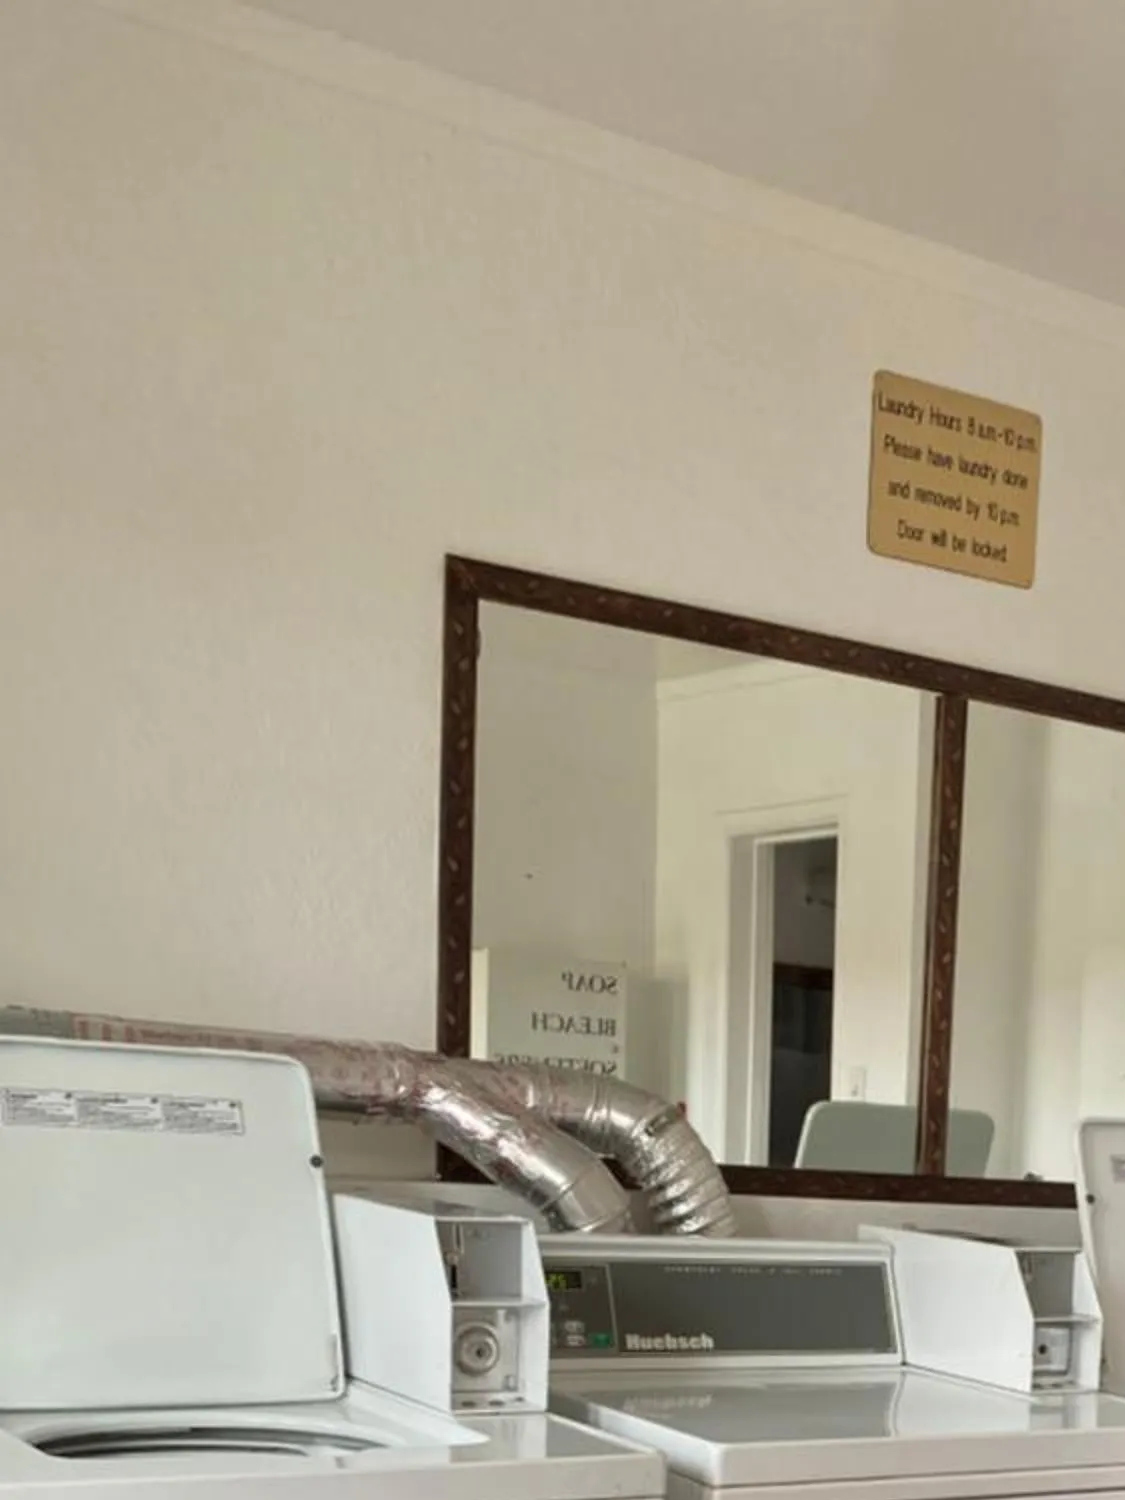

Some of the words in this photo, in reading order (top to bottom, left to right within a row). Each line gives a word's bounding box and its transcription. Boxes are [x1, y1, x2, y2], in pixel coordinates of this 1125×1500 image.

[878, 392, 924, 425] Laundry
[930, 405, 962, 432] Hours
[884, 433, 922, 460] Please
[927, 445, 952, 470] have
[958, 456, 996, 485] laundry
[1002, 468, 1028, 489] done
[888, 481, 909, 499] and
[914, 486, 962, 511] removed
[966, 496, 980, 520] by
[897, 519, 924, 541] Door
[931, 529, 947, 548] will
[952, 535, 966, 552] be
[625, 1332, 714, 1351] Huebsch
